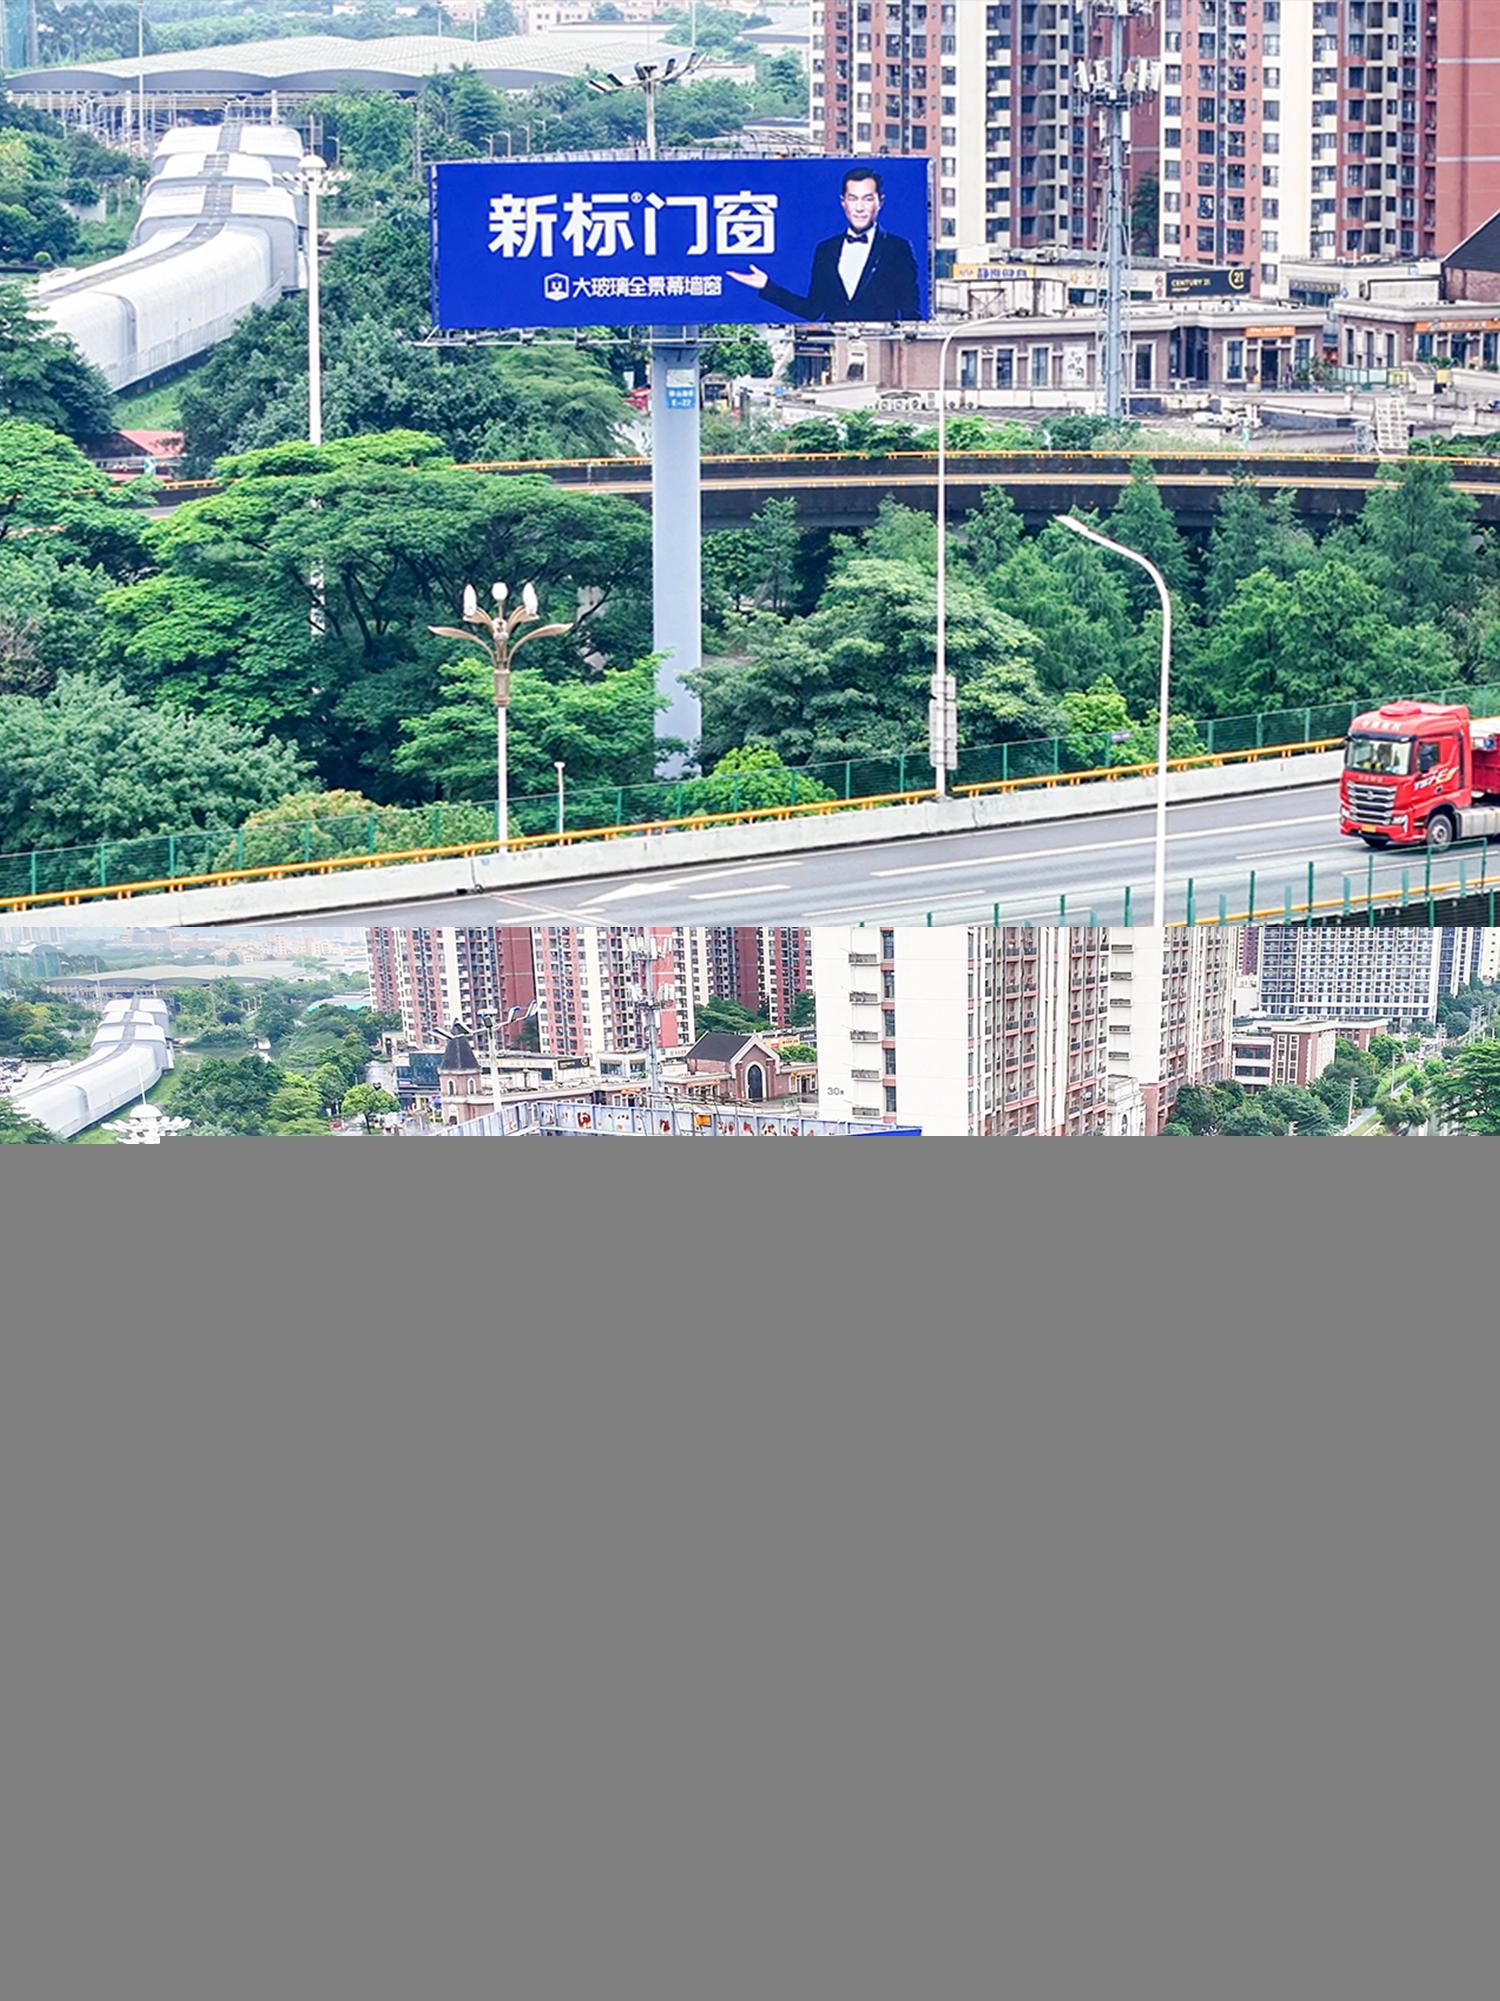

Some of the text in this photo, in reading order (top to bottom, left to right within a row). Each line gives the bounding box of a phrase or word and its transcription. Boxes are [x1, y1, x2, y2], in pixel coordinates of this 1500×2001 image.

[572, 275, 722, 298] 大玻璃全景幕墙窗
[1171, 279, 1200, 288] CENTURY
